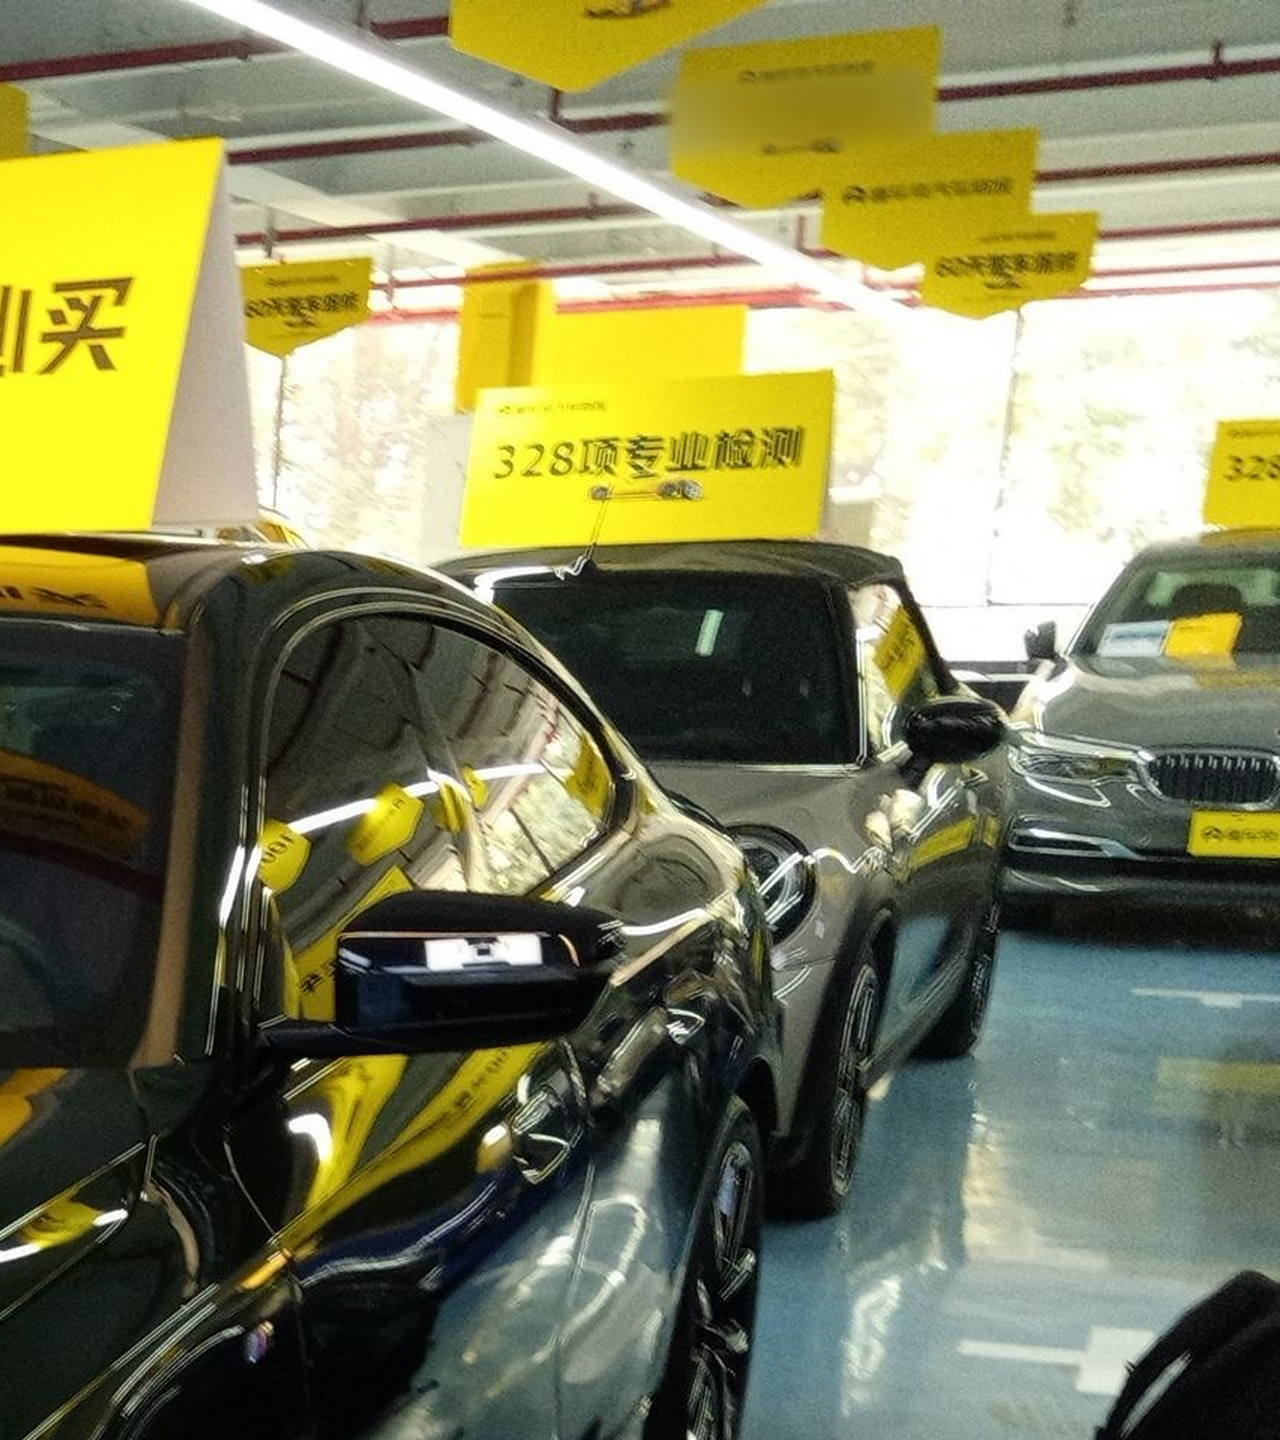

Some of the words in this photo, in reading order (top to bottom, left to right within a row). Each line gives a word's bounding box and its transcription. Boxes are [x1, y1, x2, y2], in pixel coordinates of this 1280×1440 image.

[493, 425, 807, 480] 328项专业检测
